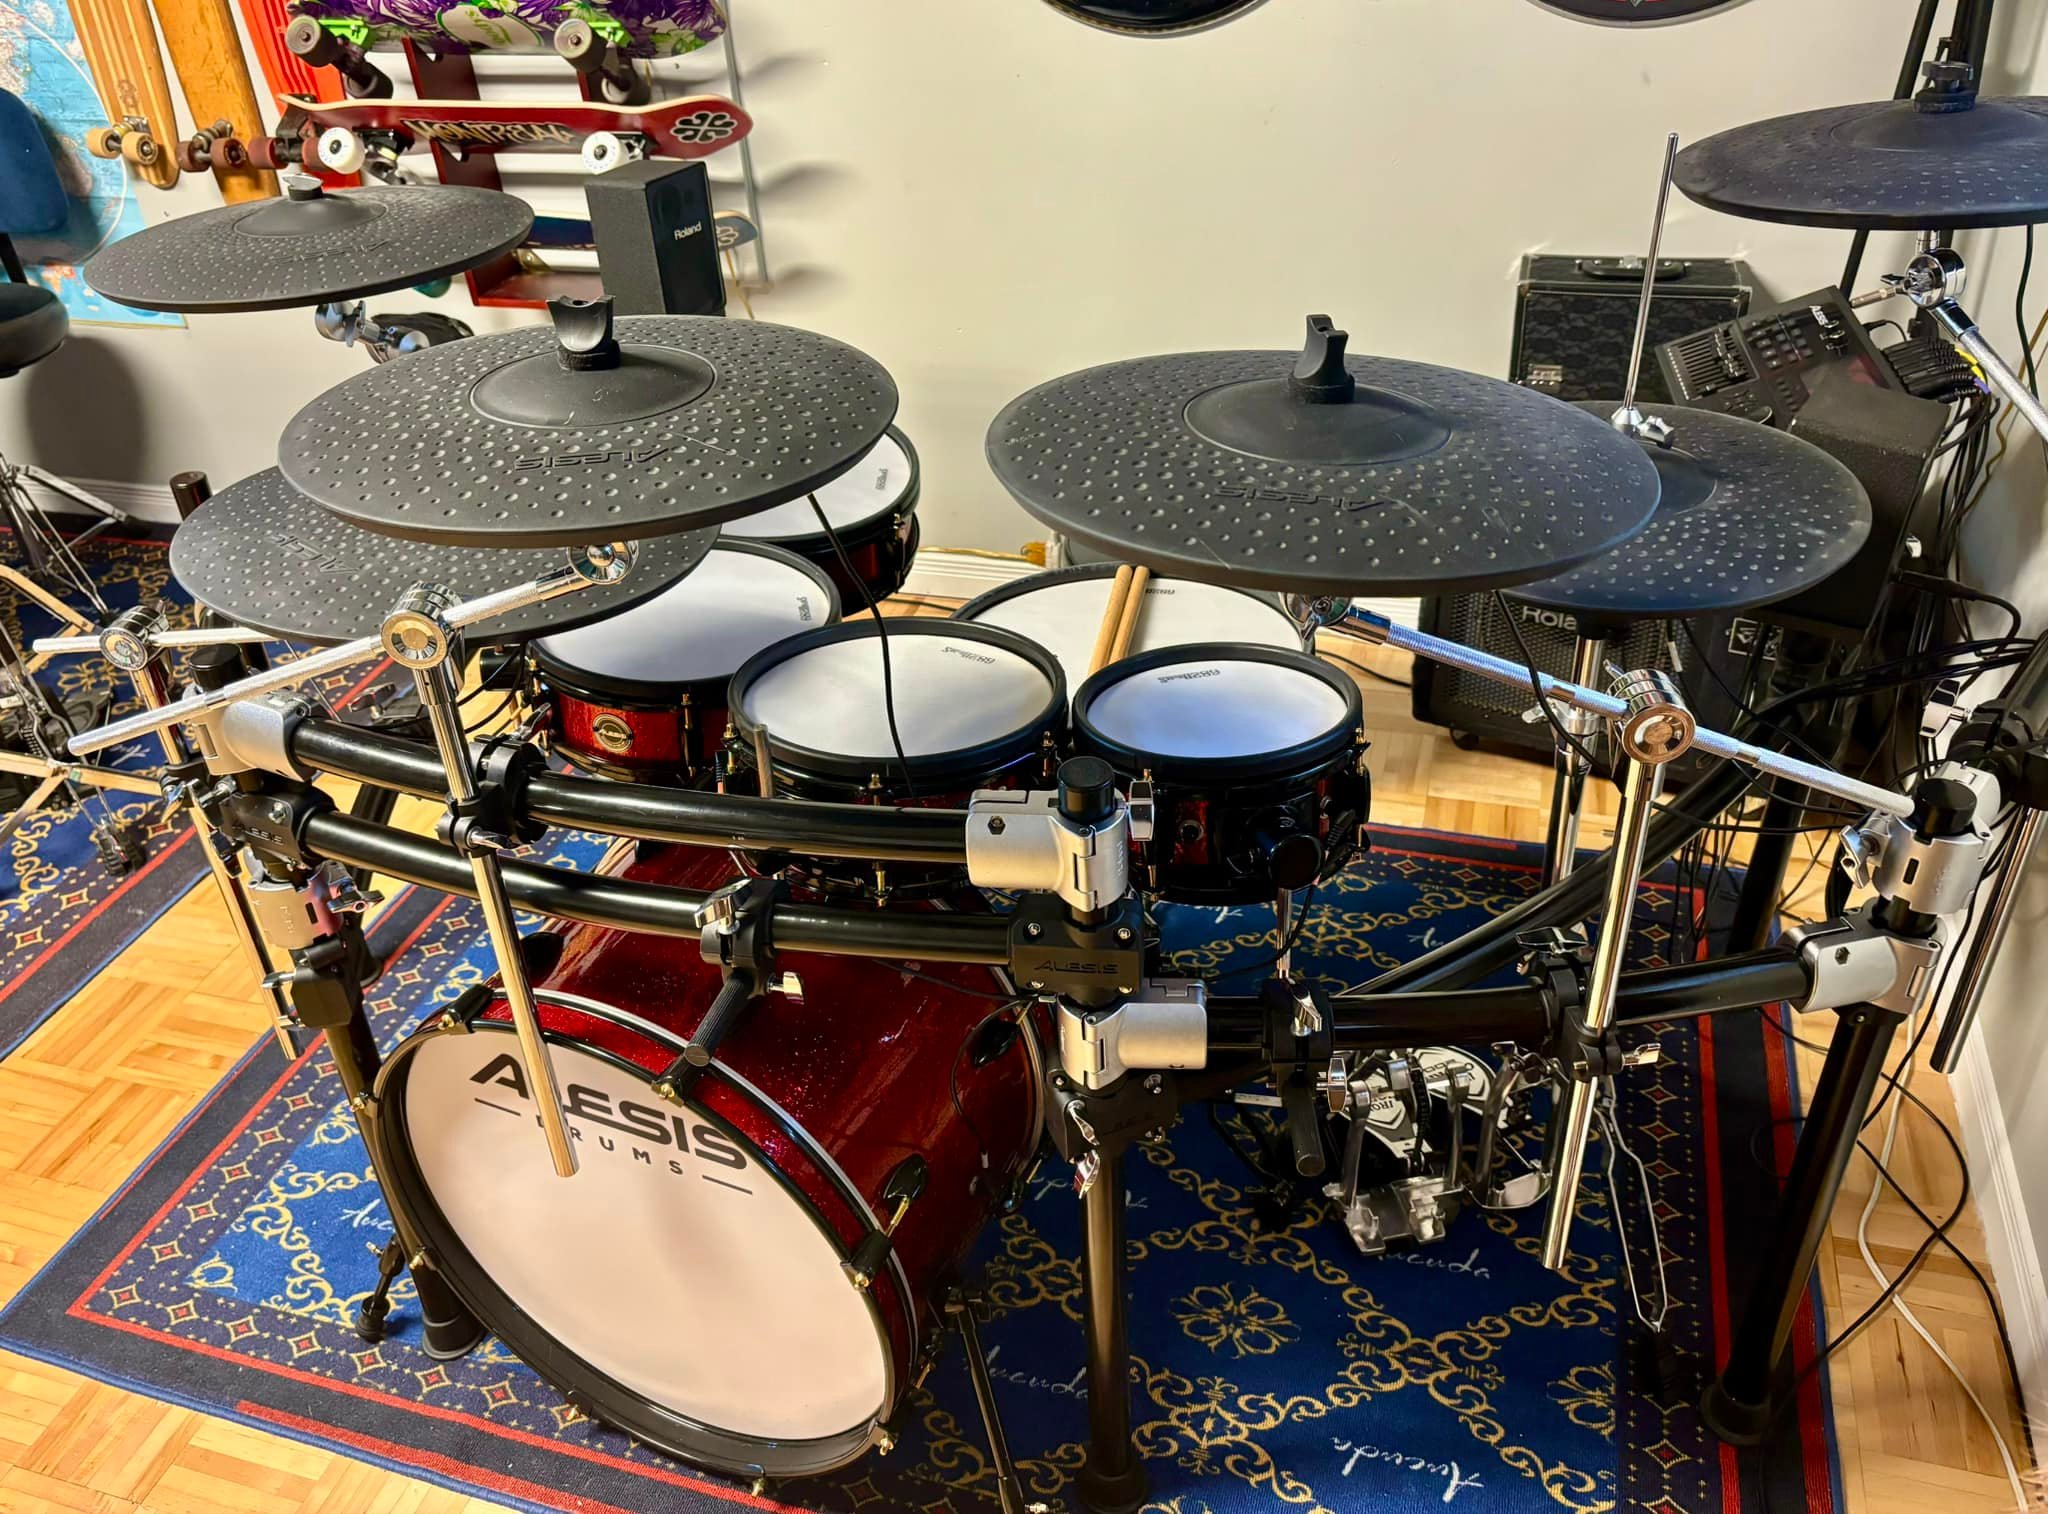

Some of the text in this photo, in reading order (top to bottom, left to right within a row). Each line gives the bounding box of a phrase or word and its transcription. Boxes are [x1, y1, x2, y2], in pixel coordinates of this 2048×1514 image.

[674, 220, 702, 241] Roland
[514, 447, 670, 471] ALESIS
[1214, 486, 1386, 512] ALESIS
[1521, 605, 1578, 631] Rola
[1033, 960, 1119, 974] ALESIS
